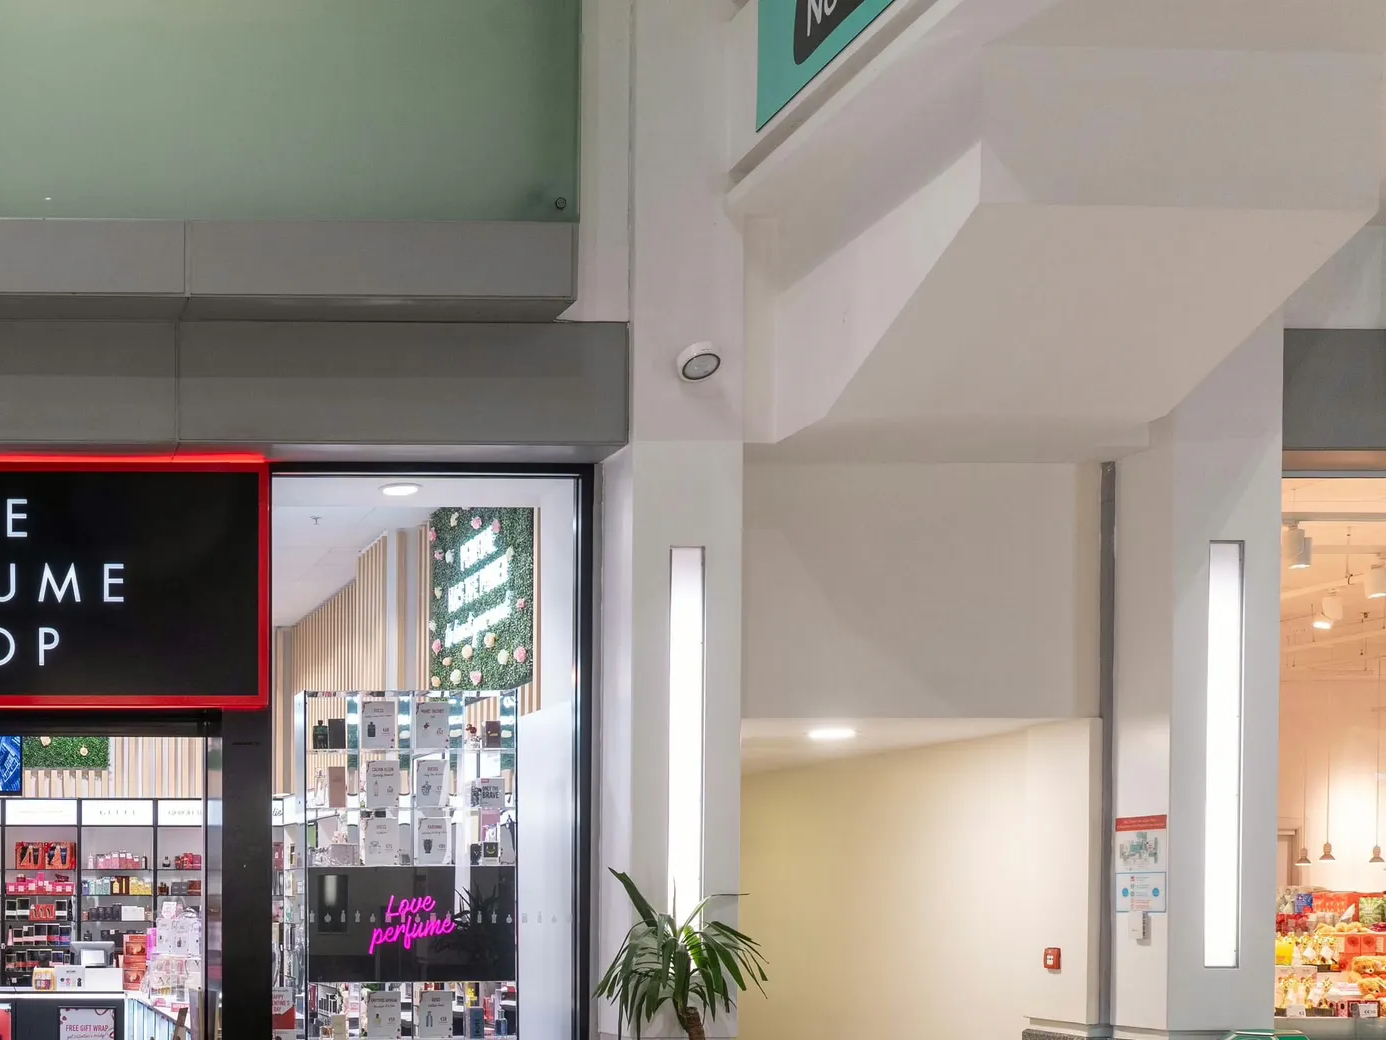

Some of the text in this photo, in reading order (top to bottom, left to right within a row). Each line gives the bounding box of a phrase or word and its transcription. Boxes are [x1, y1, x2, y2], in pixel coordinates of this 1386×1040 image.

[386, 894, 436, 918] Love
[368, 915, 458, 955] perfume
[66, 1024, 109, 1032] FREE GIFT WRAP
